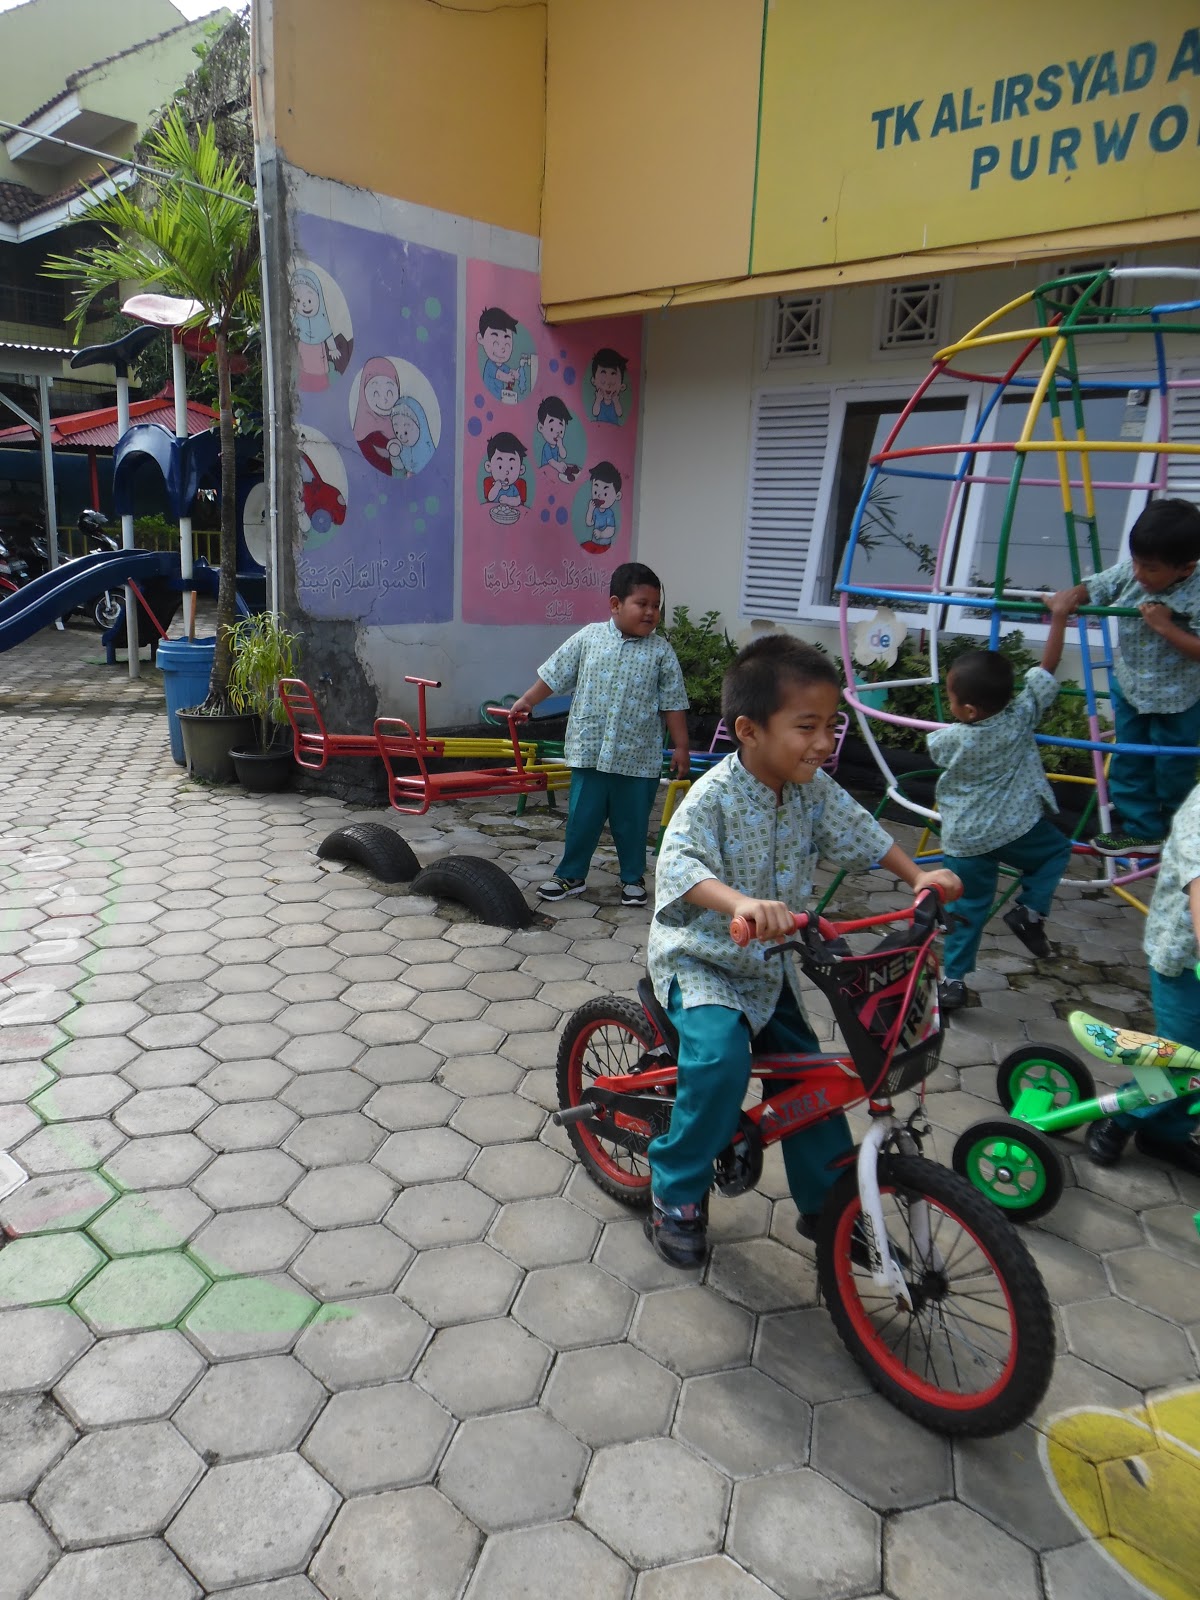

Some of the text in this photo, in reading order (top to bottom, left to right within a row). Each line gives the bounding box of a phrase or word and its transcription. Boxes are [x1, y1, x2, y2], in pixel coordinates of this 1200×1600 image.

[871, 100, 924, 150] TK
[929, 40, 1158, 138] AL-IRSYAD
[969, 104, 1200, 191] PURWO
